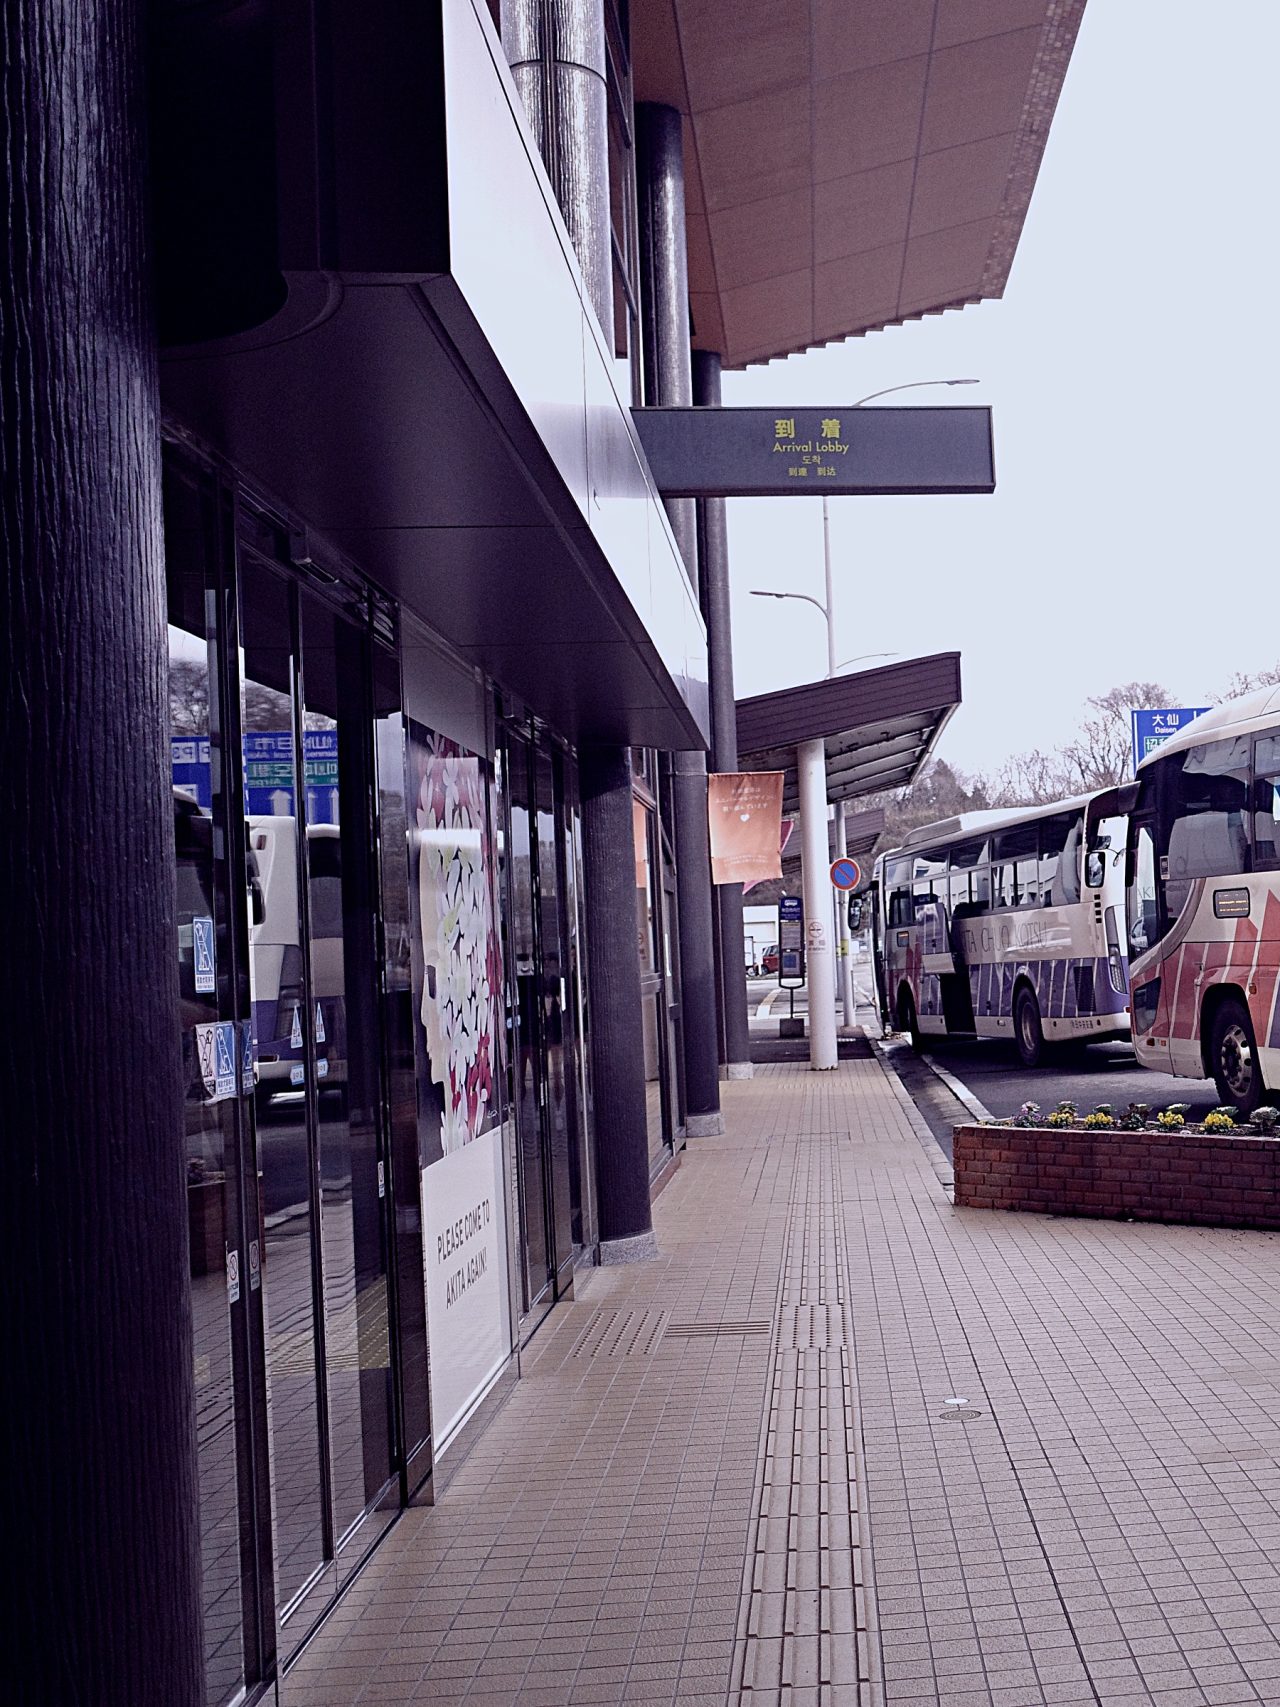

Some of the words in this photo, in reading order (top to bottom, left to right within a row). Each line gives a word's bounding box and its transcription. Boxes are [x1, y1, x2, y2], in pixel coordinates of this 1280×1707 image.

[773, 441, 812, 453] Arrival
[815, 440, 849, 455] Lobby
[1152, 713, 1180, 727] 大仙
[1154, 726, 1178, 735] Daisen
[437, 1218, 464, 1265] PLEASE
[464, 1204, 481, 1241] COME
[482, 1198, 490, 1227] TO
[446, 1267, 466, 1310] AKITA
[466, 1246, 488, 1290] AGAIN!
